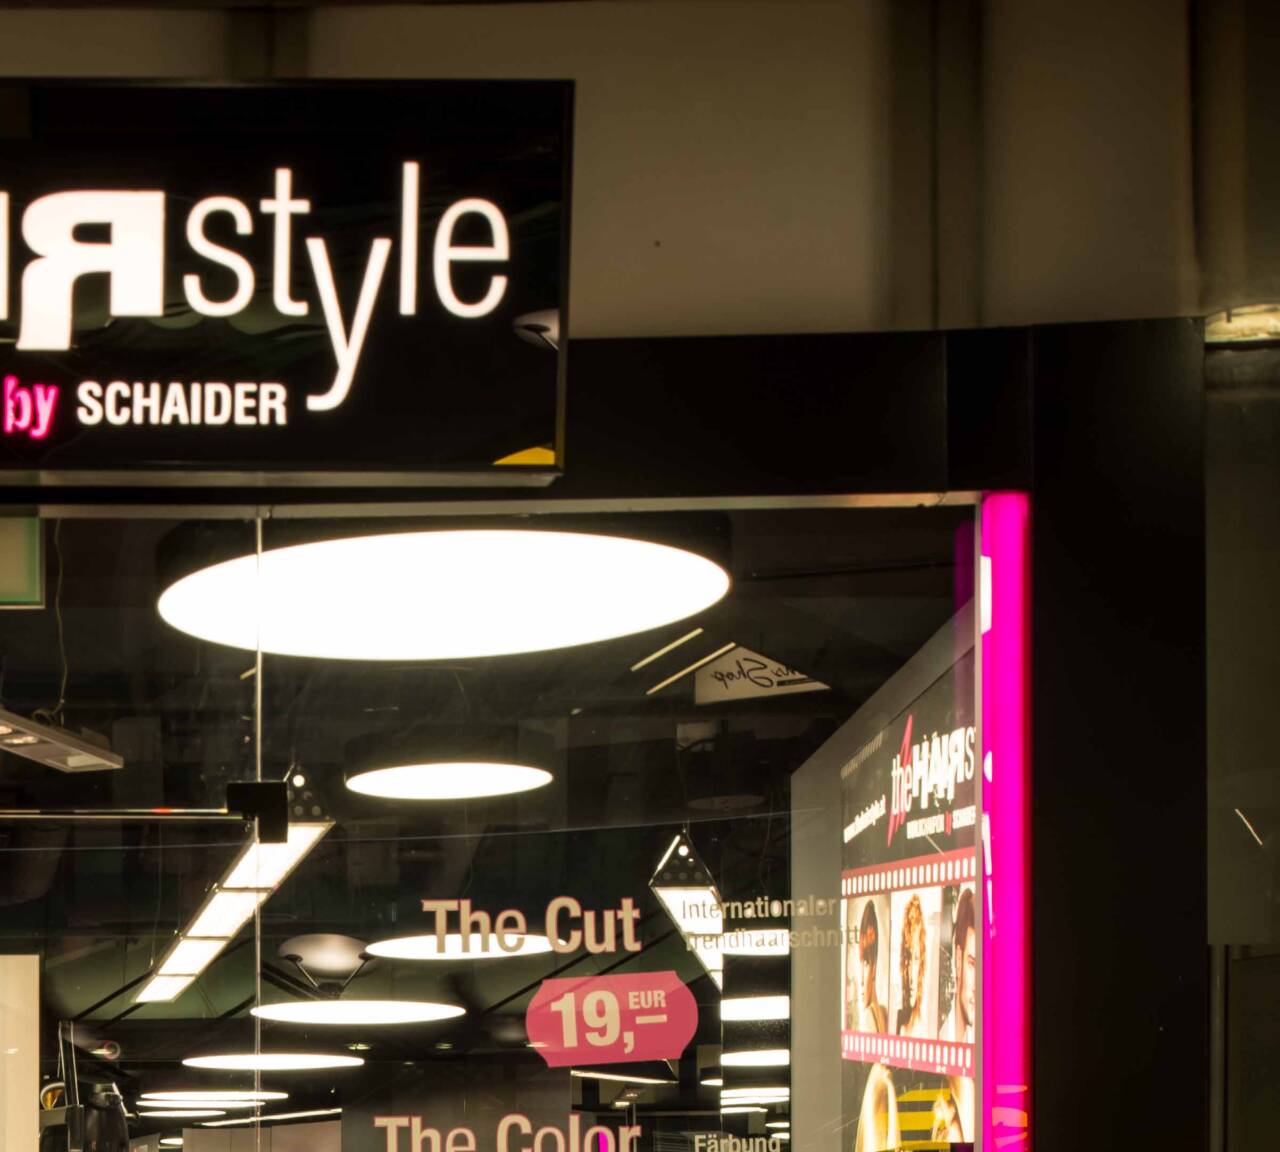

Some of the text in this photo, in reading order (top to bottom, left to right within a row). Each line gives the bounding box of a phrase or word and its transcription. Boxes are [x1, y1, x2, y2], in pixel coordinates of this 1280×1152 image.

[182, 161, 511, 412] style
[3, 375, 59, 440] by
[76, 381, 287, 426] SCHAIDER
[422, 895, 643, 955] The Cut
[681, 896, 837, 921] Internationaler
[628, 989, 667, 1010] EUR
